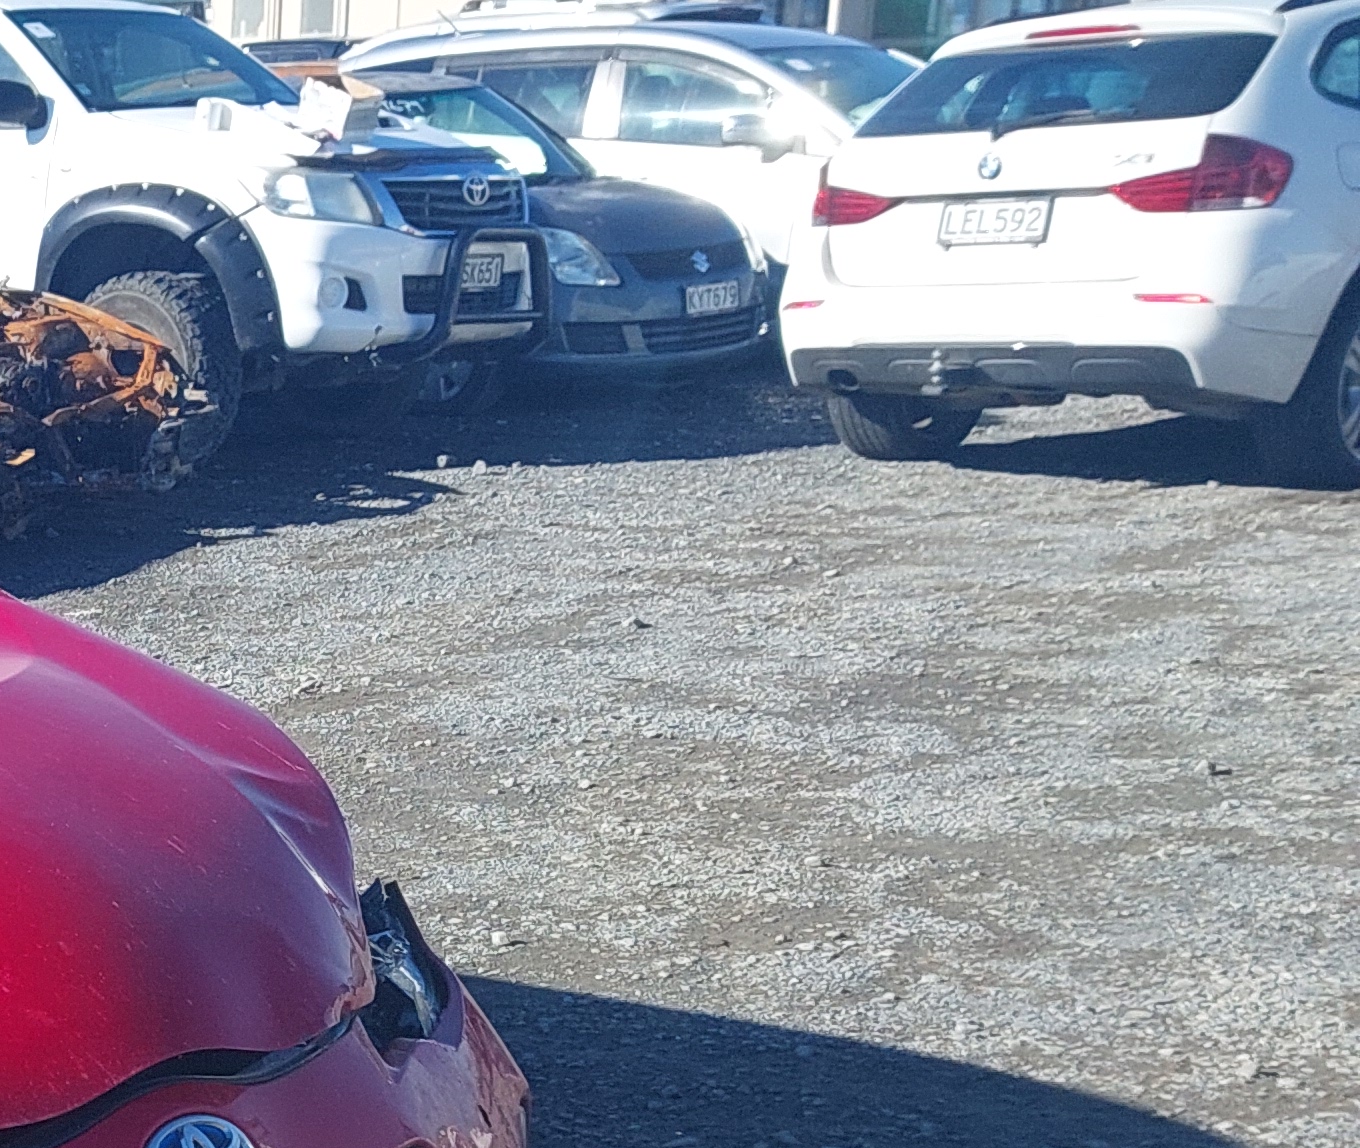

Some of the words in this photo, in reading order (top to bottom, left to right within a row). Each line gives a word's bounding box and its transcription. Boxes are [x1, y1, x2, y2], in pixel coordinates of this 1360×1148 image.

[943, 206, 1043, 236] LEL592
[462, 260, 500, 284] SK651
[687, 284, 737, 310] KYT679
